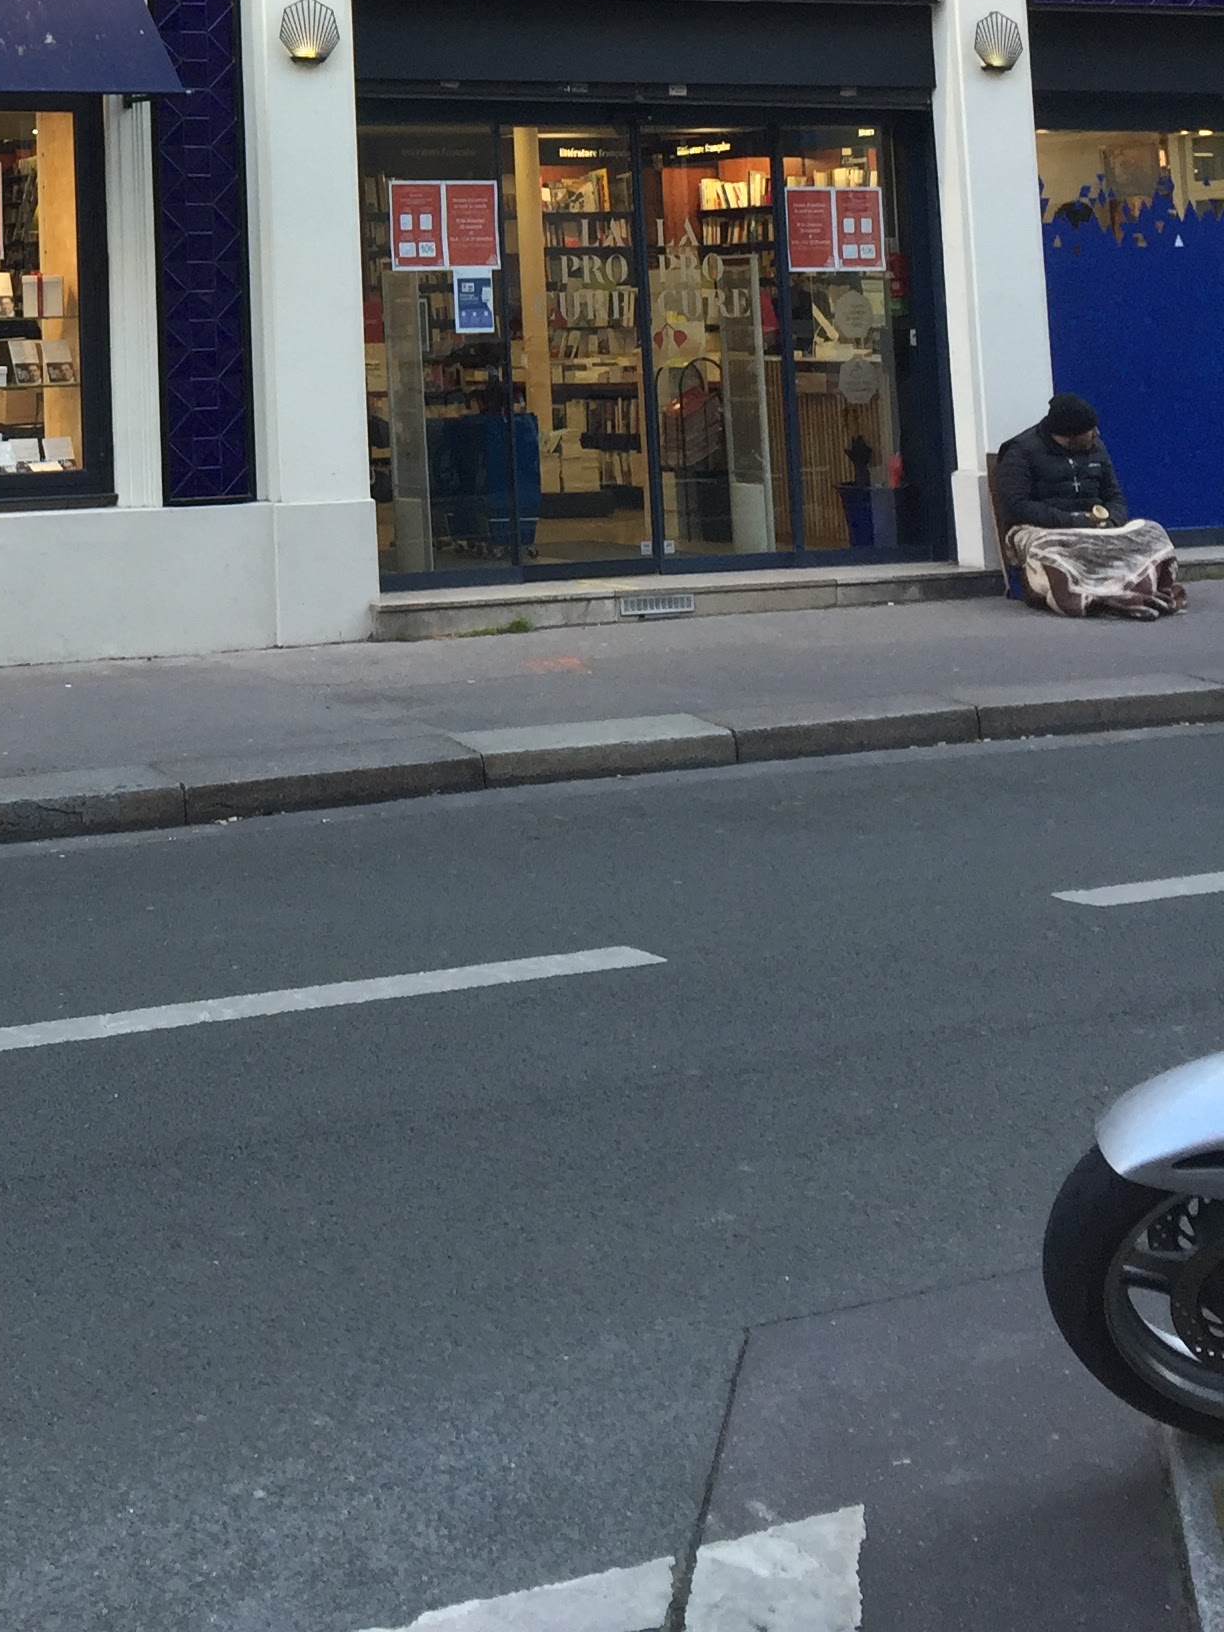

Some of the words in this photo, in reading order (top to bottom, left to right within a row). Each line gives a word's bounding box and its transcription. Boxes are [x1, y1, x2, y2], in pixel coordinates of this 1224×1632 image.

[580, 217, 626, 248] LA
[656, 217, 700, 248] LA
[560, 253, 629, 285] PRO
[658, 253, 726, 284] PRO
[657, 288, 752, 320] CURE
